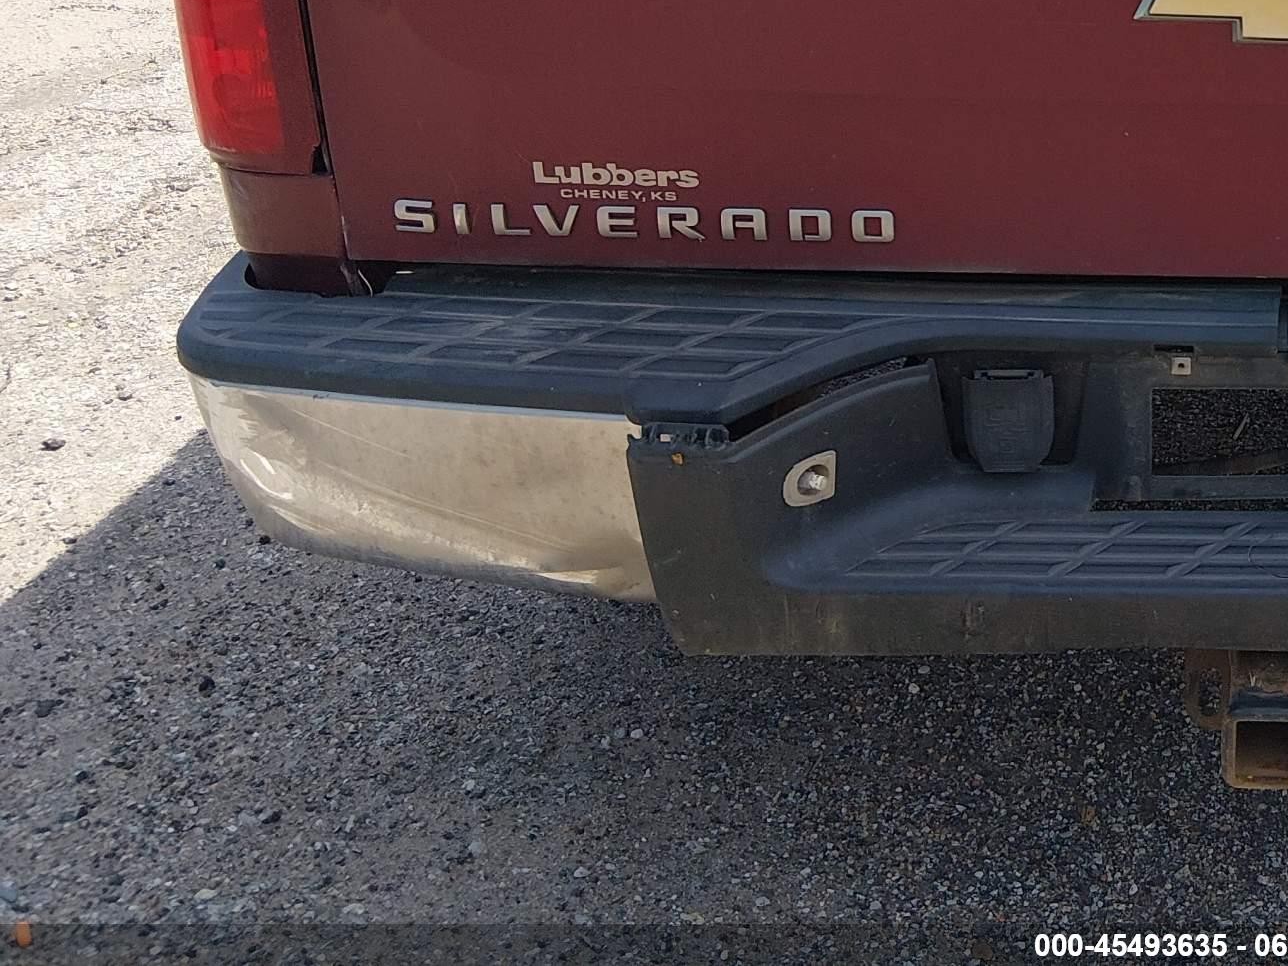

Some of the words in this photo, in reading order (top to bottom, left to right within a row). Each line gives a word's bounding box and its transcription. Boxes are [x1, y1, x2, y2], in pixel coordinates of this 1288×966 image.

[532, 161, 700, 188] Lubbers
[559, 188, 647, 202] CHENEY,
[650, 191, 678, 202] KS
[393, 198, 896, 244] SILVERADO
